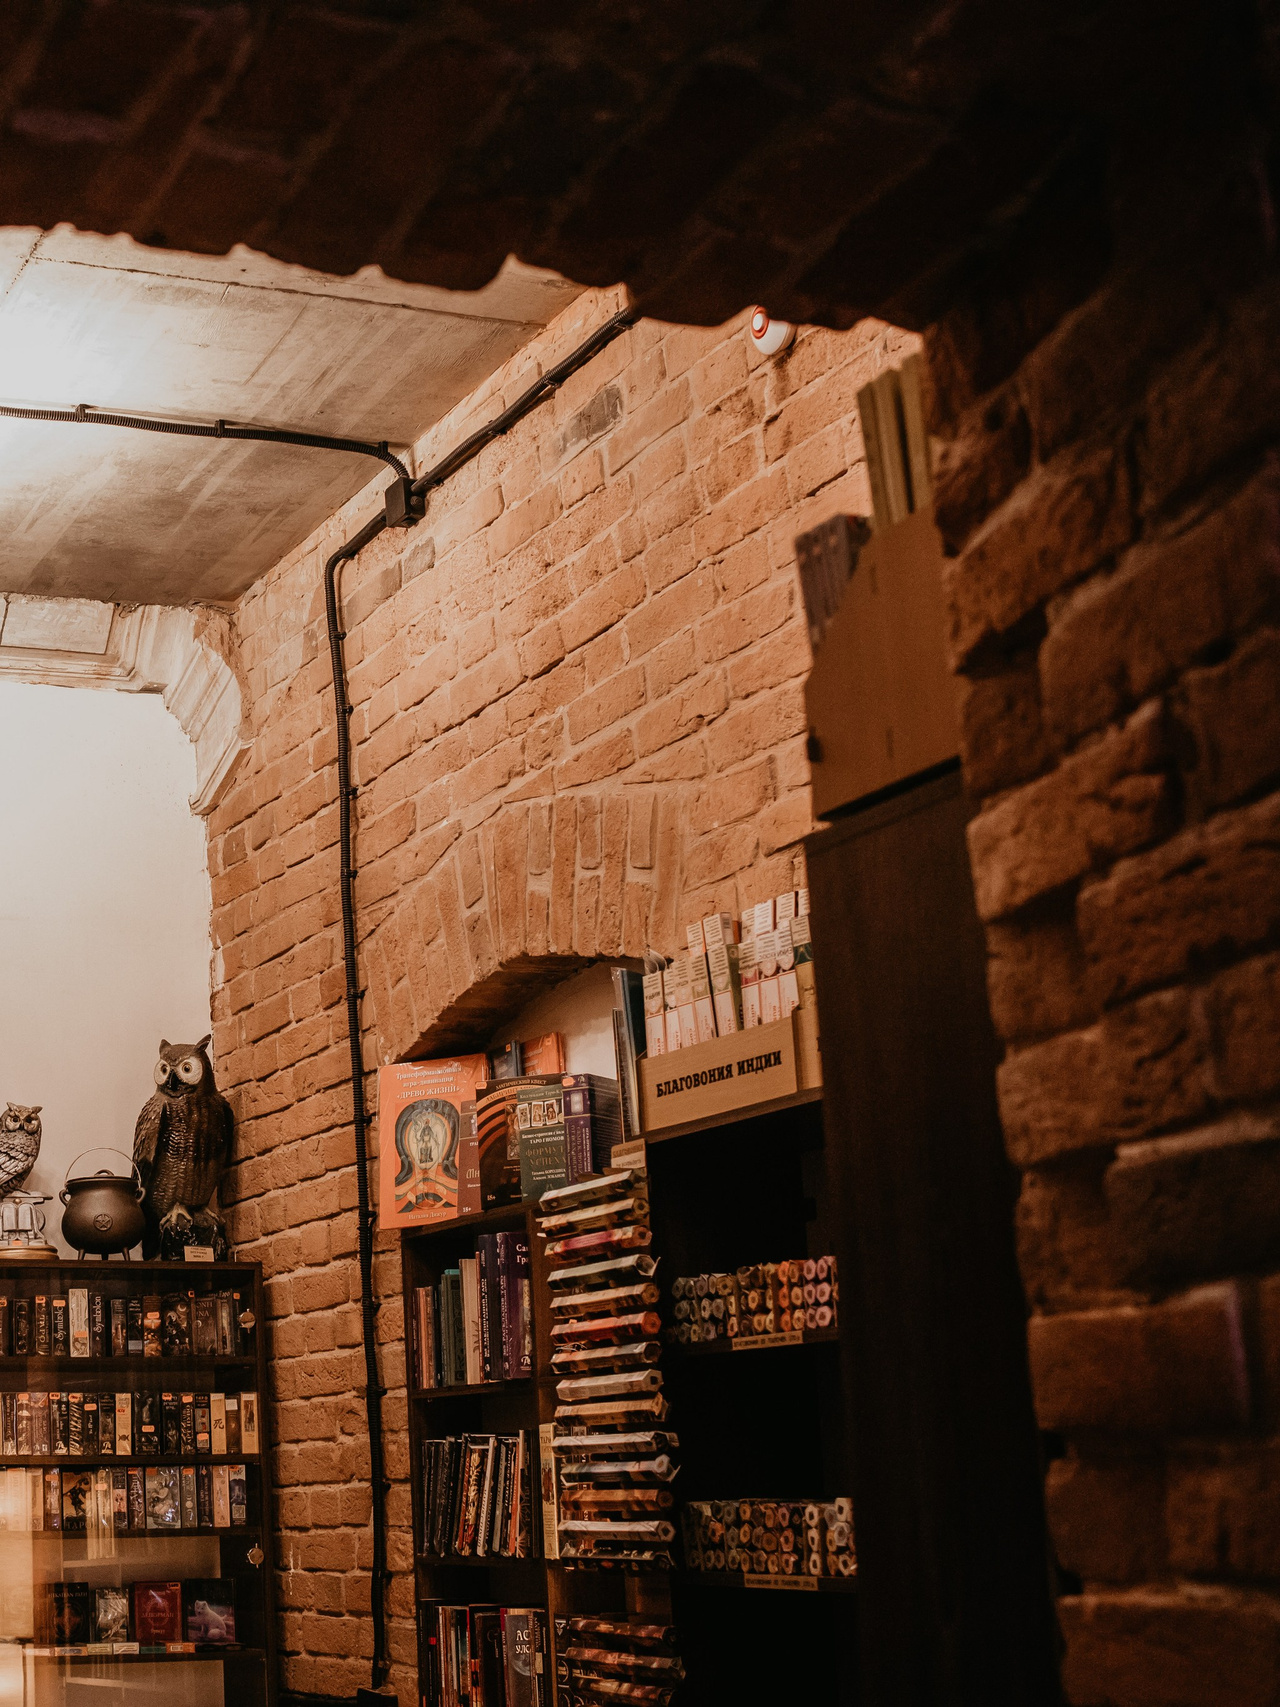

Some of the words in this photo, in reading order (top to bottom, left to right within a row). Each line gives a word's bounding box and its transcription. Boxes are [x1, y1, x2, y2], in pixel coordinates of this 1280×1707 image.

[656, 1063, 734, 1098] БЛАГОВОНИЯ
[737, 1050, 783, 1077] ИНДИИ
[53, 1305, 66, 1340] Symbolo
[92, 1295, 104, 1334] Symbolon
[213, 1418, 225, 1430] 死
